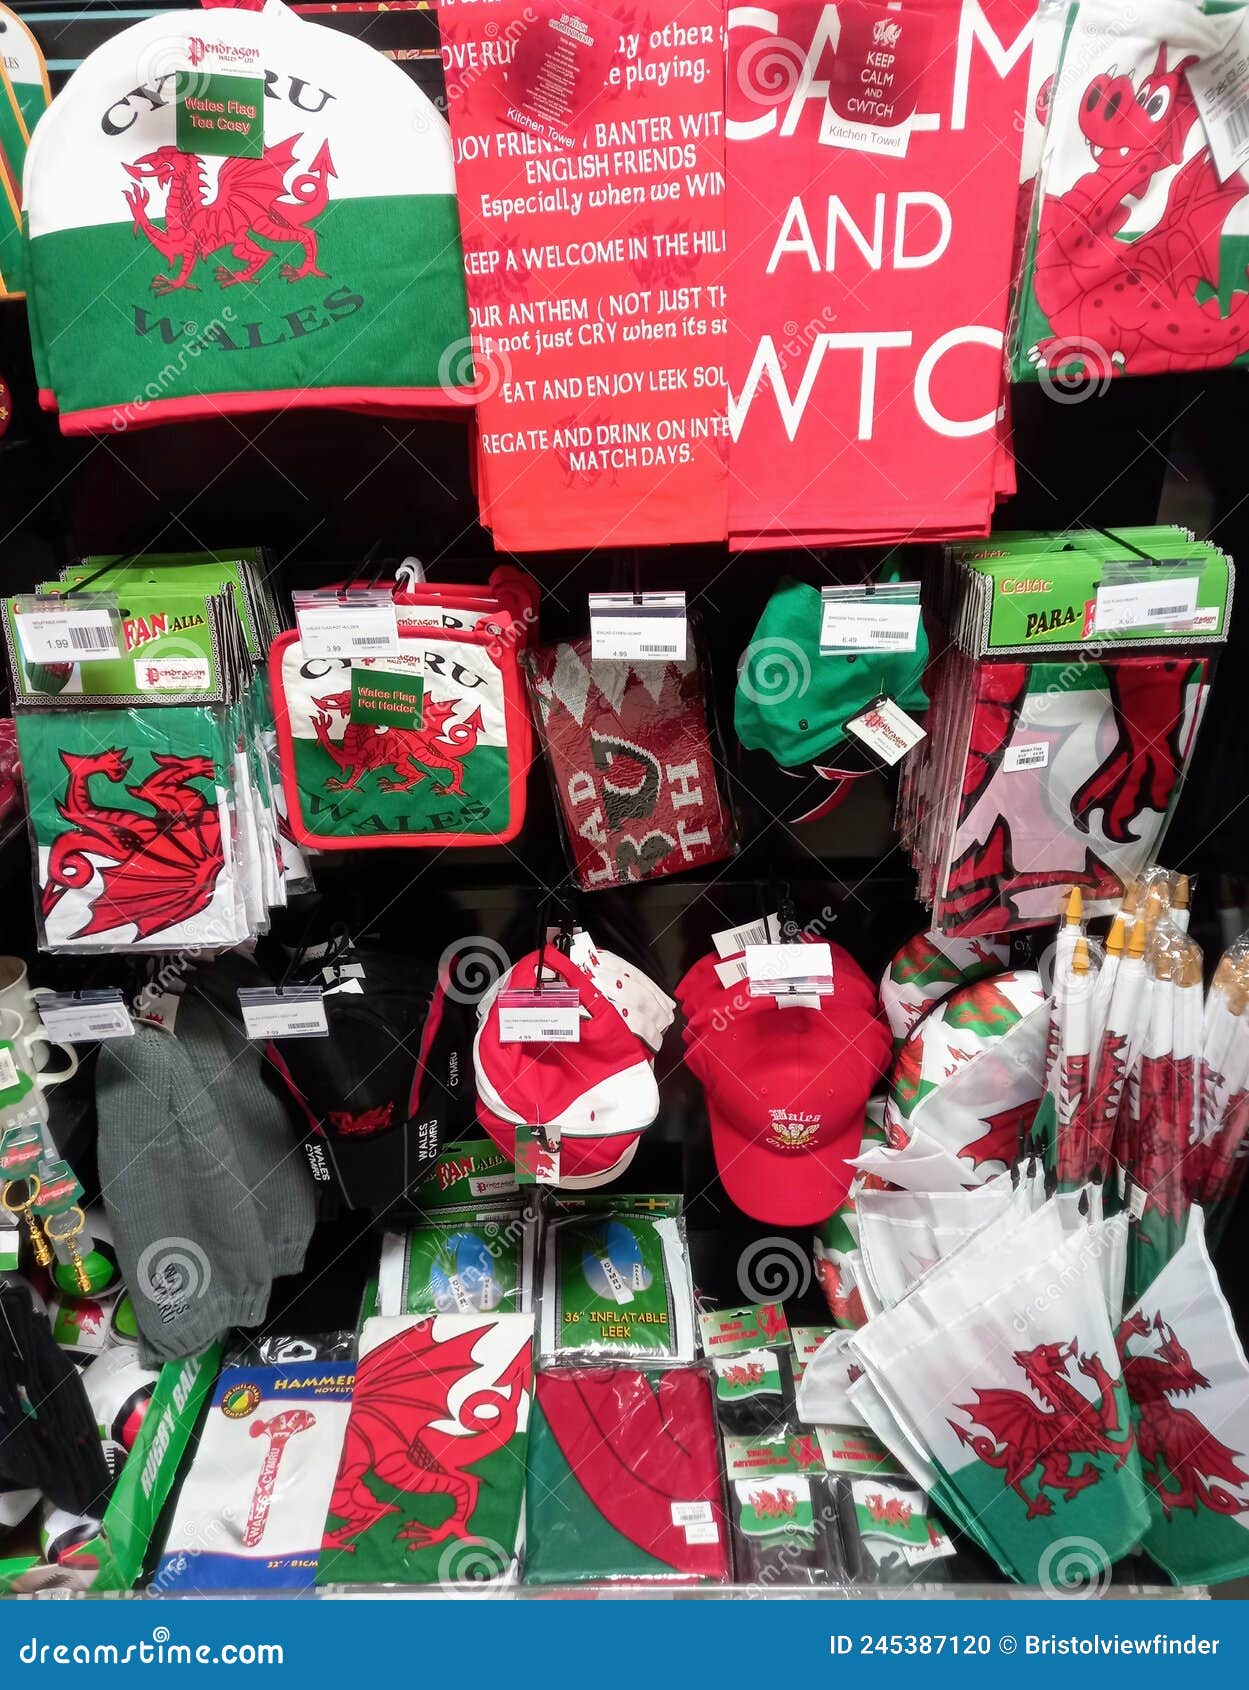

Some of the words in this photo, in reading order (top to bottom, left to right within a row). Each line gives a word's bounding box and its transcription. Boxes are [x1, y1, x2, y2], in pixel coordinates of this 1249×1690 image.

[649, 21, 714, 49] other
[187, 36, 259, 67] Pendragon
[866, 50, 895, 69] KEEP
[625, 55, 711, 91] playing.
[860, 68, 895, 88] CALM
[101, 69, 337, 136] CYRU
[184, 96, 225, 113] Wales
[227, 100, 257, 119] Flag
[847, 97, 894, 119] CWTCH
[864, 87, 883, 99] AND
[190, 114, 215, 129] Tea
[217, 117, 251, 136] Cosy
[506, 106, 546, 134] Kitchen
[547, 125, 576, 149] Towel
[594, 116, 674, 148] BANTER
[828, 125, 868, 142] Kitchen
[870, 131, 901, 148] Towel
[525, 152, 610, 185] ENGLISH
[613, 143, 698, 178] FRIENDS
[480, 187, 584, 222] Especially
[589, 182, 646, 209] when
[650, 181, 681, 202] we
[765, 190, 954, 275] AND
[464, 250, 500, 276] KEEP
[505, 248, 519, 272] A
[523, 238, 625, 270] WELCOME
[628, 236, 649, 259] IN
[652, 232, 689, 257] THE
[131, 285, 365, 352] WALES
[507, 297, 590, 325] ANTHEM
[609, 290, 652, 317] NOT
[656, 286, 702, 314] JUST
[499, 330, 532, 354] not
[534, 326, 574, 357] just
[577, 320, 618, 346] CRY
[622, 319, 678, 343] when
[680, 317, 708, 337] its
[503, 380, 538, 405] EAT
[541, 376, 584, 402] AND
[586, 371, 646, 398] ENJOY
[648, 367, 690, 392] LEEK
[481, 429, 549, 455] REGATE
[552, 426, 594, 451] AND
[596, 421, 652, 449] DRINK
[656, 419, 687, 443] ON
[568, 445, 638, 473] MATCH
[641, 442, 697, 466] DAYS.
[1000, 578, 1054, 595] Celtic
[397, 617, 440, 626] endragon
[46, 639, 69, 649] 1.99
[144, 666, 206, 686] Pendragon
[358, 686, 391, 699] Wales
[393, 690, 417, 704] Flag
[358, 698, 377, 709] Pot
[378, 699, 416, 714] Holder
[308, 791, 492, 833] WALES
[449, 1051, 458, 1087] CYMRU
[768, 1108, 822, 1123] Wales
[418, 1122, 429, 1162] WALES
[428, 1119, 439, 1159] CYMRU
[305, 1143, 322, 1181] CYMRU
[313, 1144, 330, 1181] WALES
[604, 1262, 622, 1290] CYMRU
[589, 1311, 668, 1324] INFLATABLE
[602, 1326, 632, 1339] LEEK
[141, 1403, 176, 1499] RUGBY
